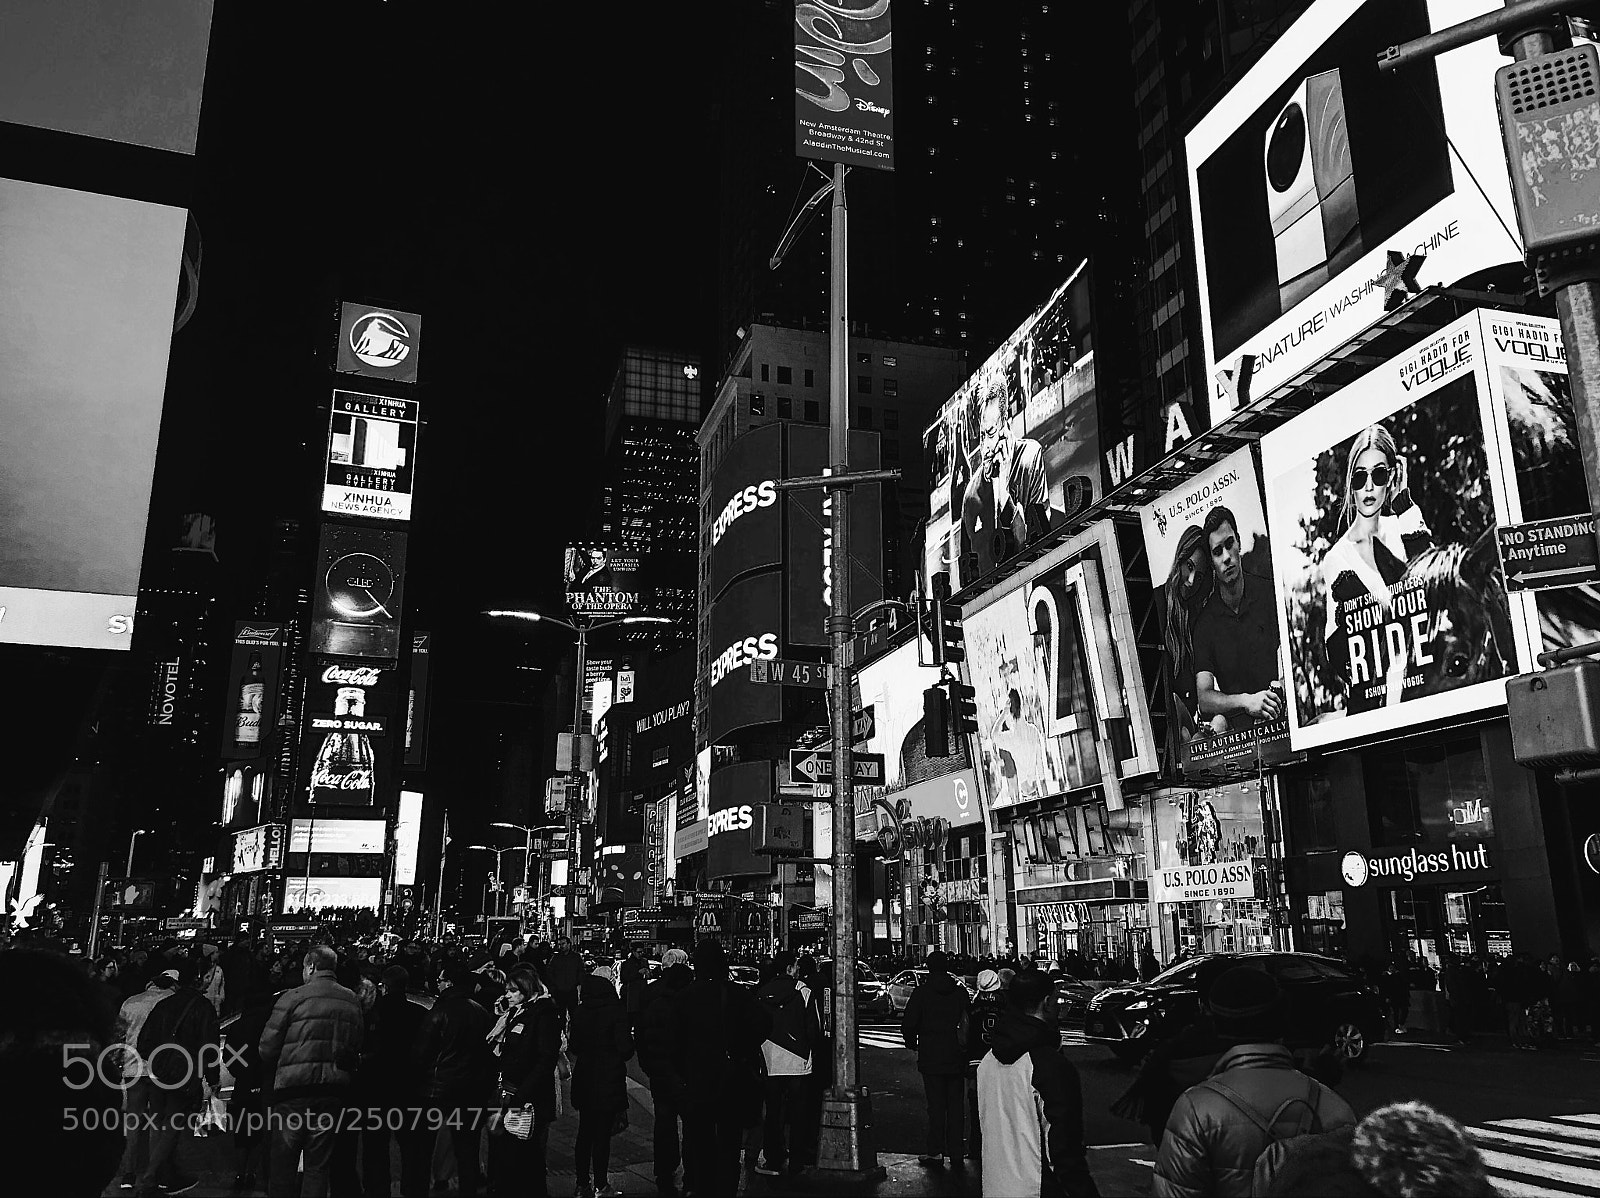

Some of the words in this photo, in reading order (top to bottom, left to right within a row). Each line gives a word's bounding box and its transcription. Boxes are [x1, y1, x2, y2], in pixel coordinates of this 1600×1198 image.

[854, 97, 891, 118] Disney
[799, 119, 817, 128] New
[818, 122, 861, 136] Amsterdam
[808, 128, 846, 142] Broadway
[855, 136, 875, 145] 42nd
[875, 140, 885, 148] St
[802, 139, 890, 159] AladdinTheMusical.com
[1253, 310, 1325, 375] GNATURE
[1328, 268, 1388, 318] WASHIN
[1490, 324, 1514, 338] GIGI
[1517, 328, 1549, 342] HADID
[1399, 360, 1418, 378] GIGI
[1420, 342, 1448, 366] HADID
[1452, 330, 1470, 348] FOR
[345, 402, 406, 418] GALLERY
[378, 397, 407, 409] XINHUA
[346, 473, 396, 486] GALLERY
[343, 491, 393, 507] XINHUA
[1168, 501, 1186, 518] U.S.
[1185, 485, 1210, 509] POLO
[1212, 469, 1240, 494] ASSN.
[330, 501, 361, 513] NEWS
[362, 504, 404, 517] AGENCY
[713, 480, 777, 546] EXPRESS
[1184, 505, 1204, 521] SINCE
[1206, 495, 1223, 509] 1890
[1504, 531, 1525, 546] NO
[1508, 543, 1567, 561] Anytime
[565, 592, 639, 604] PHANTOM
[571, 602, 584, 610] OF
[586, 602, 603, 610] THE
[603, 602, 632, 610] OPERA
[1343, 595, 1363, 613] DON'T
[1345, 603, 1383, 635] SHOW
[1388, 588, 1428, 620] YOUR
[862, 637, 868, 656] 7
[1347, 612, 1434, 687] RIDE
[711, 633, 778, 687] EXPRESS
[321, 664, 381, 686] Coca-Cola
[771, 662, 785, 682] W
[792, 664, 810, 684] 45
[158, 656, 180, 725] NOVOTEL
[239, 716, 260, 728] Bud
[311, 718, 343, 729] ZERO
[343, 720, 384, 731] SUGAR.
[636, 715, 652, 734] WILL
[652, 708, 668, 727] YOU
[668, 700, 690, 721] PLAY?
[1190, 743, 1208, 754] LIVE
[1212, 720, 1287, 749] AUTHENTICALLY
[805, 761, 831, 774] ONE
[314, 768, 370, 790] Coca-Cola
[707, 804, 753, 838] EXPRES
[551, 840, 560, 849] 45
[647, 809, 657, 885] PALACE
[1369, 847, 1450, 882] sunglass
[1451, 843, 1490, 871] hut
[1162, 871, 1184, 889] U.S.
[1186, 868, 1218, 887] POLO
[1184, 888, 1210, 898] SINCE
[1212, 887, 1235, 897] 1890
[1037, 922, 1047, 957] SALE
